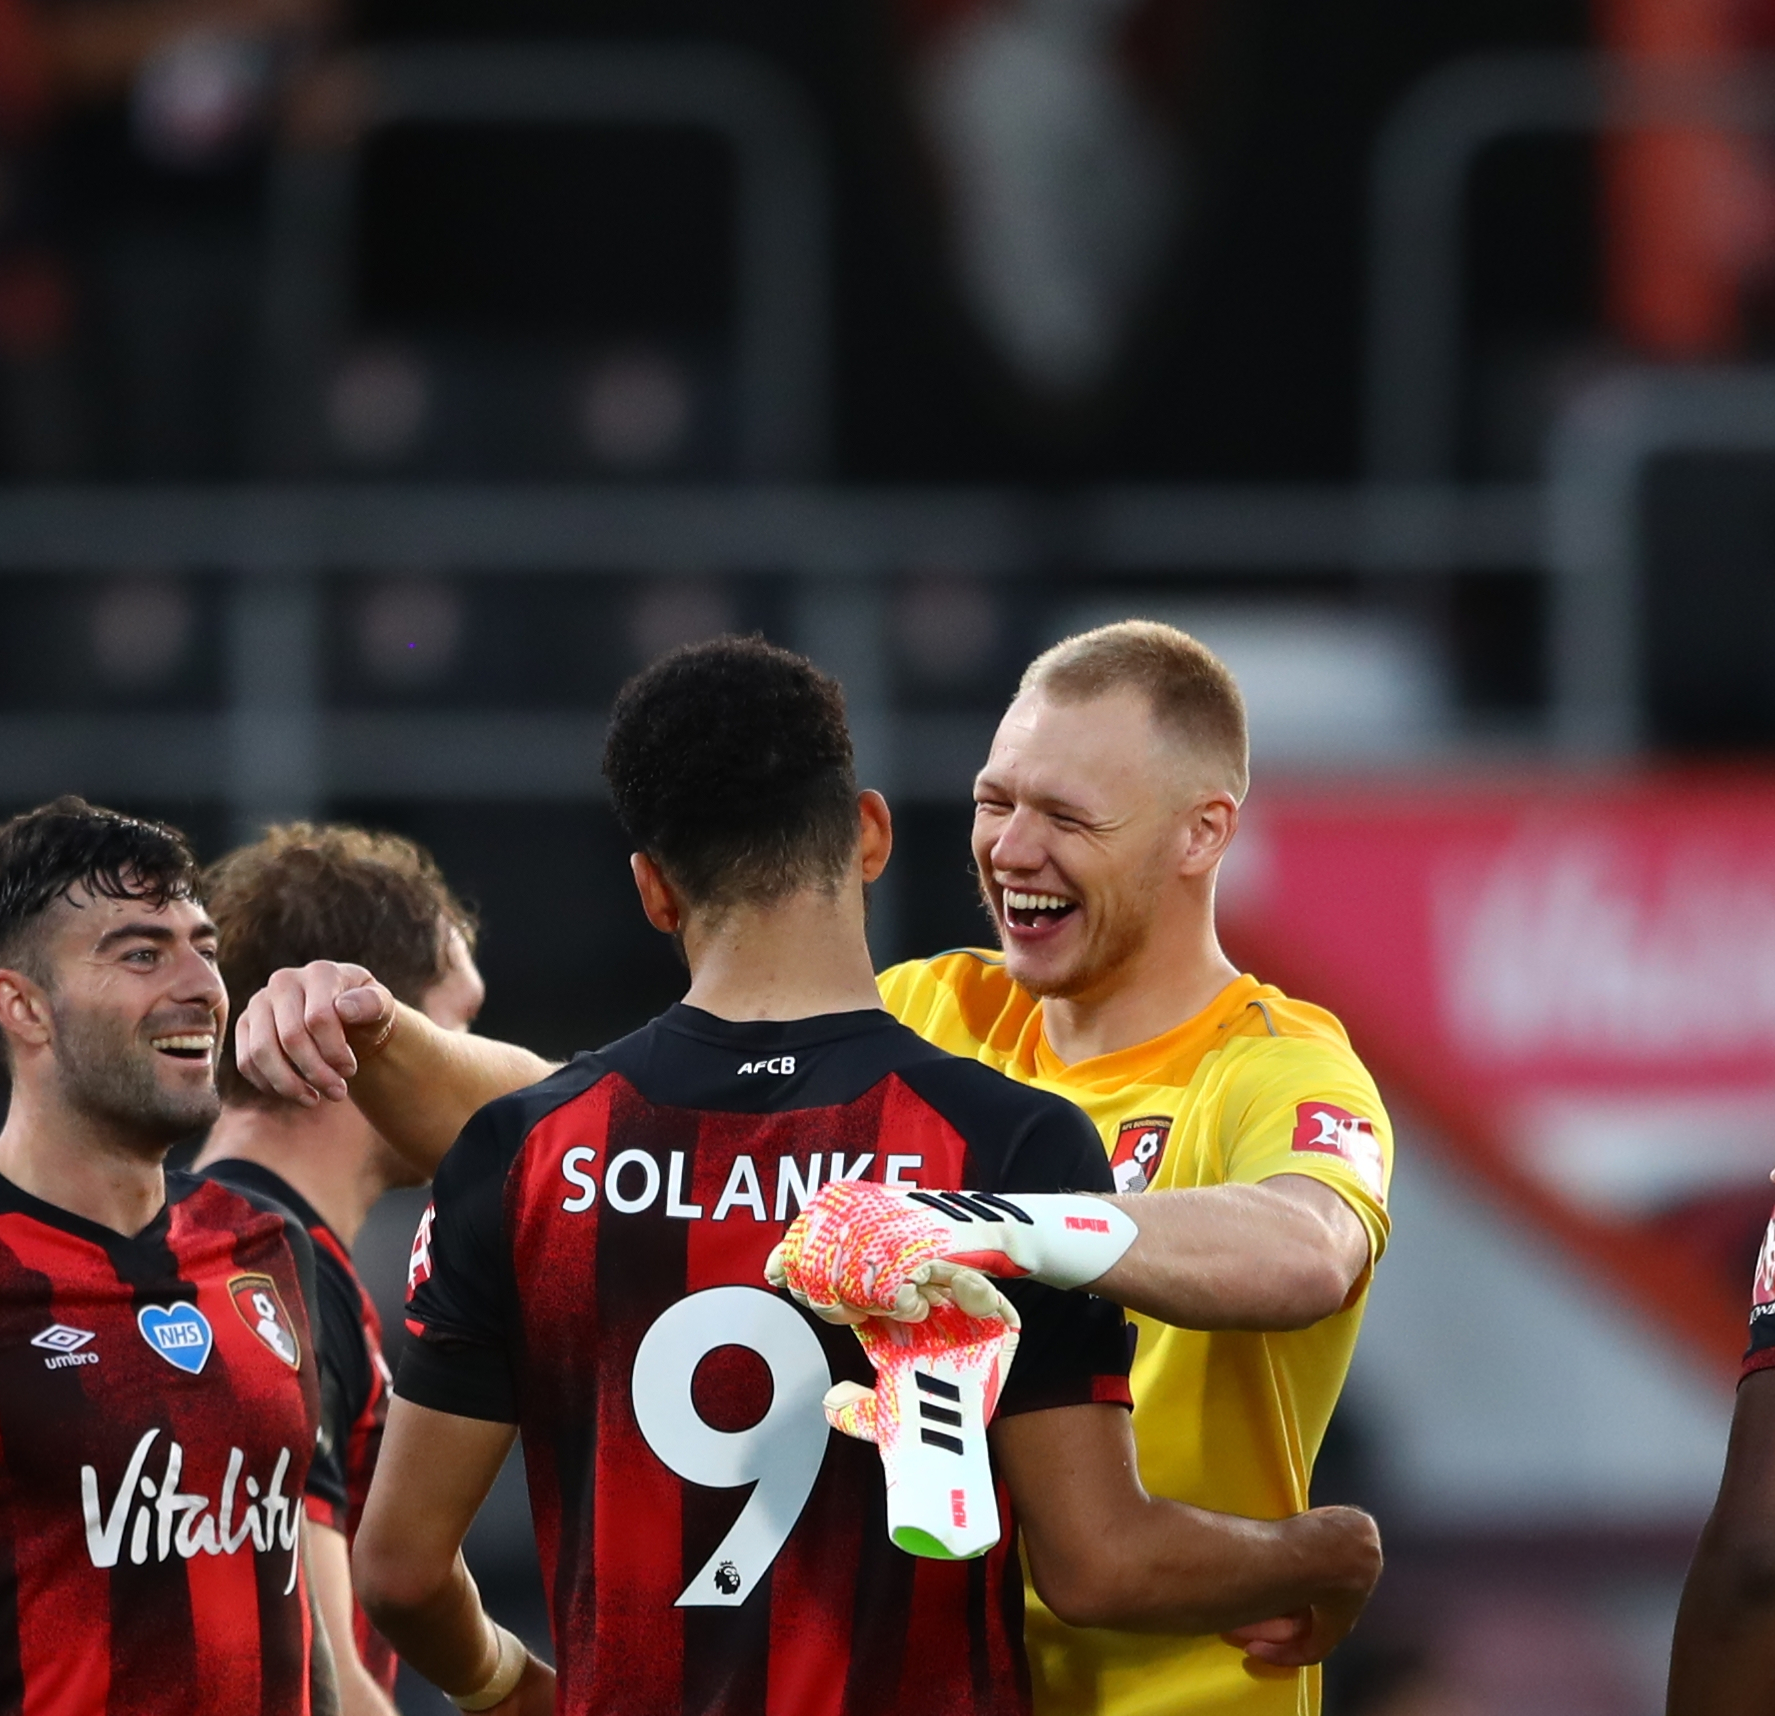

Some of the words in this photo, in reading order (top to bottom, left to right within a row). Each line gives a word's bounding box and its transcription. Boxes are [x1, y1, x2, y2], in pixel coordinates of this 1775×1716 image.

[737, 1056, 796, 1075] AFCB
[159, 1325, 198, 1347] NHS
[44, 1351, 100, 1370] umbro
[631, 1285, 833, 1607] 9
[80, 1428, 302, 1596] Vitality
